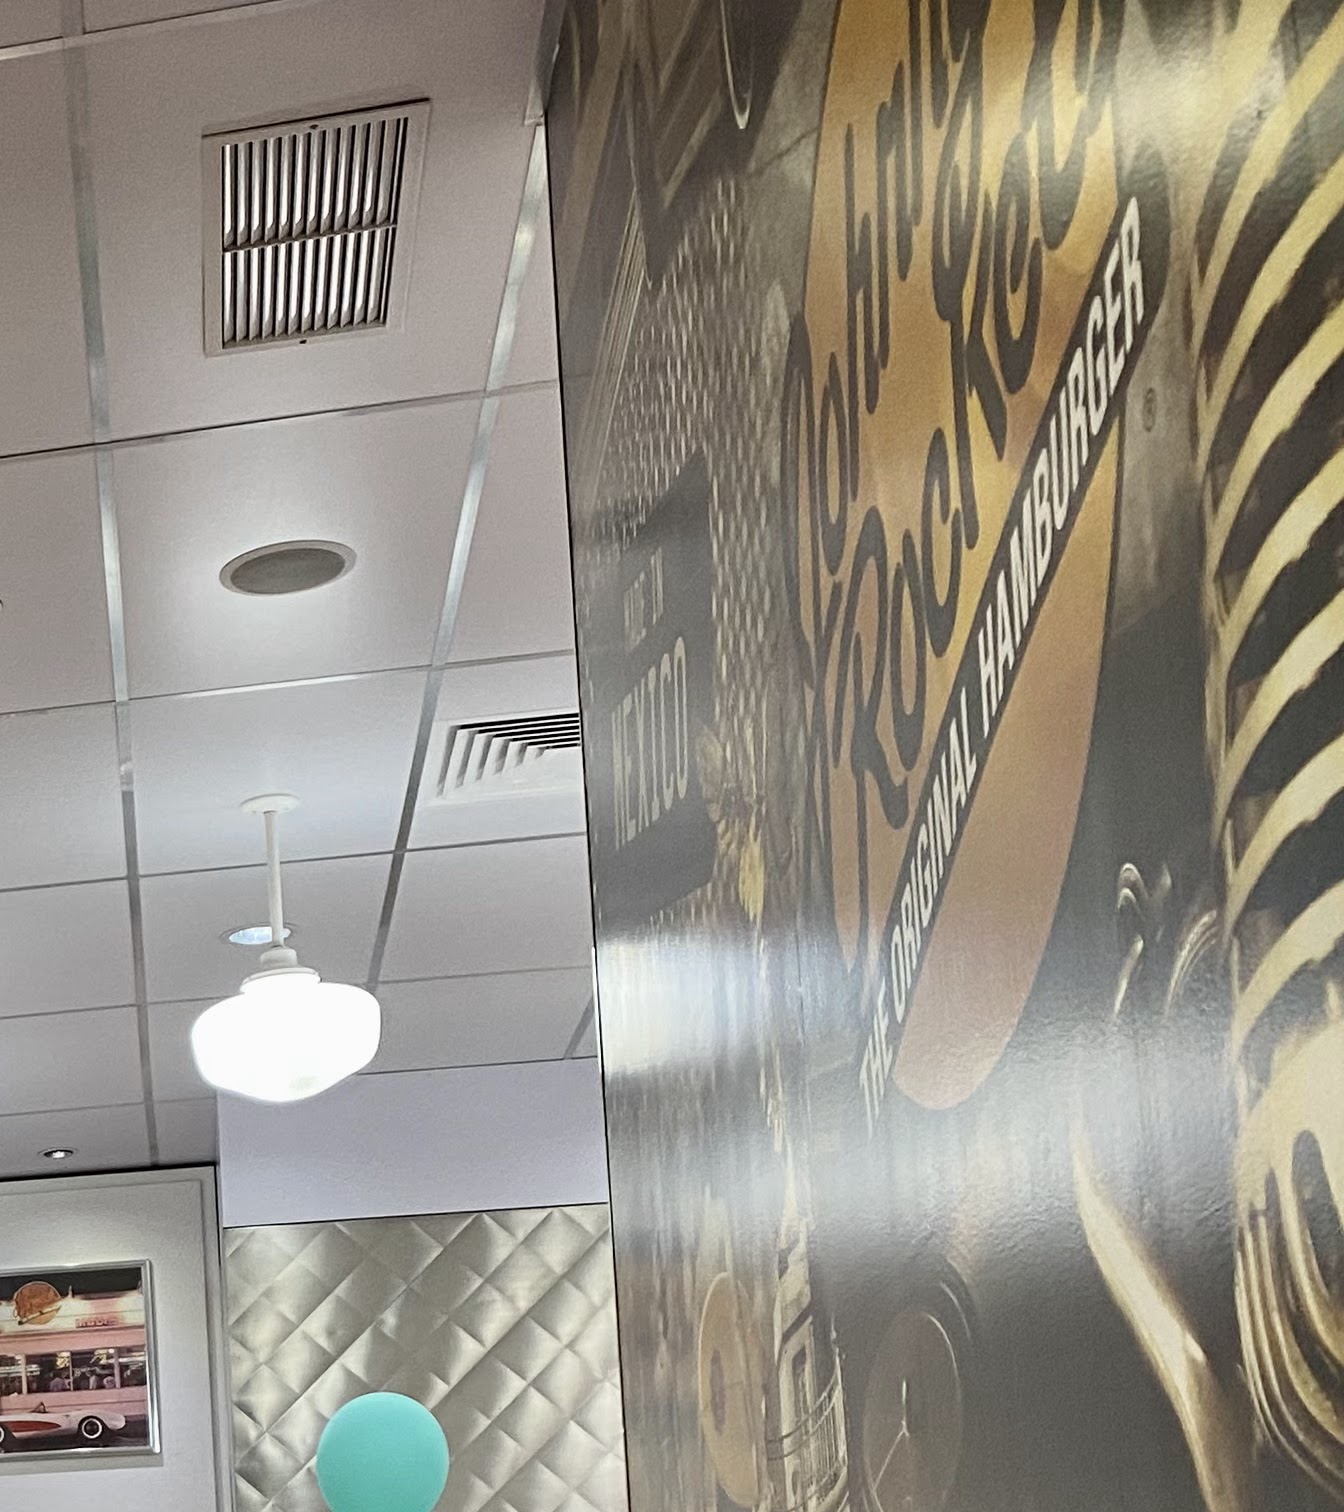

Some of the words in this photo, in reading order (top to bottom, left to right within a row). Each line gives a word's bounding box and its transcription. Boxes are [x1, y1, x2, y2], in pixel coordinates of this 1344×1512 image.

[612, 635, 689, 851] MEXICO
[858, 977, 894, 1142] THE
[889, 688, 979, 1025] ORIGINAL
[978, 196, 1146, 740] HAMBURGER
